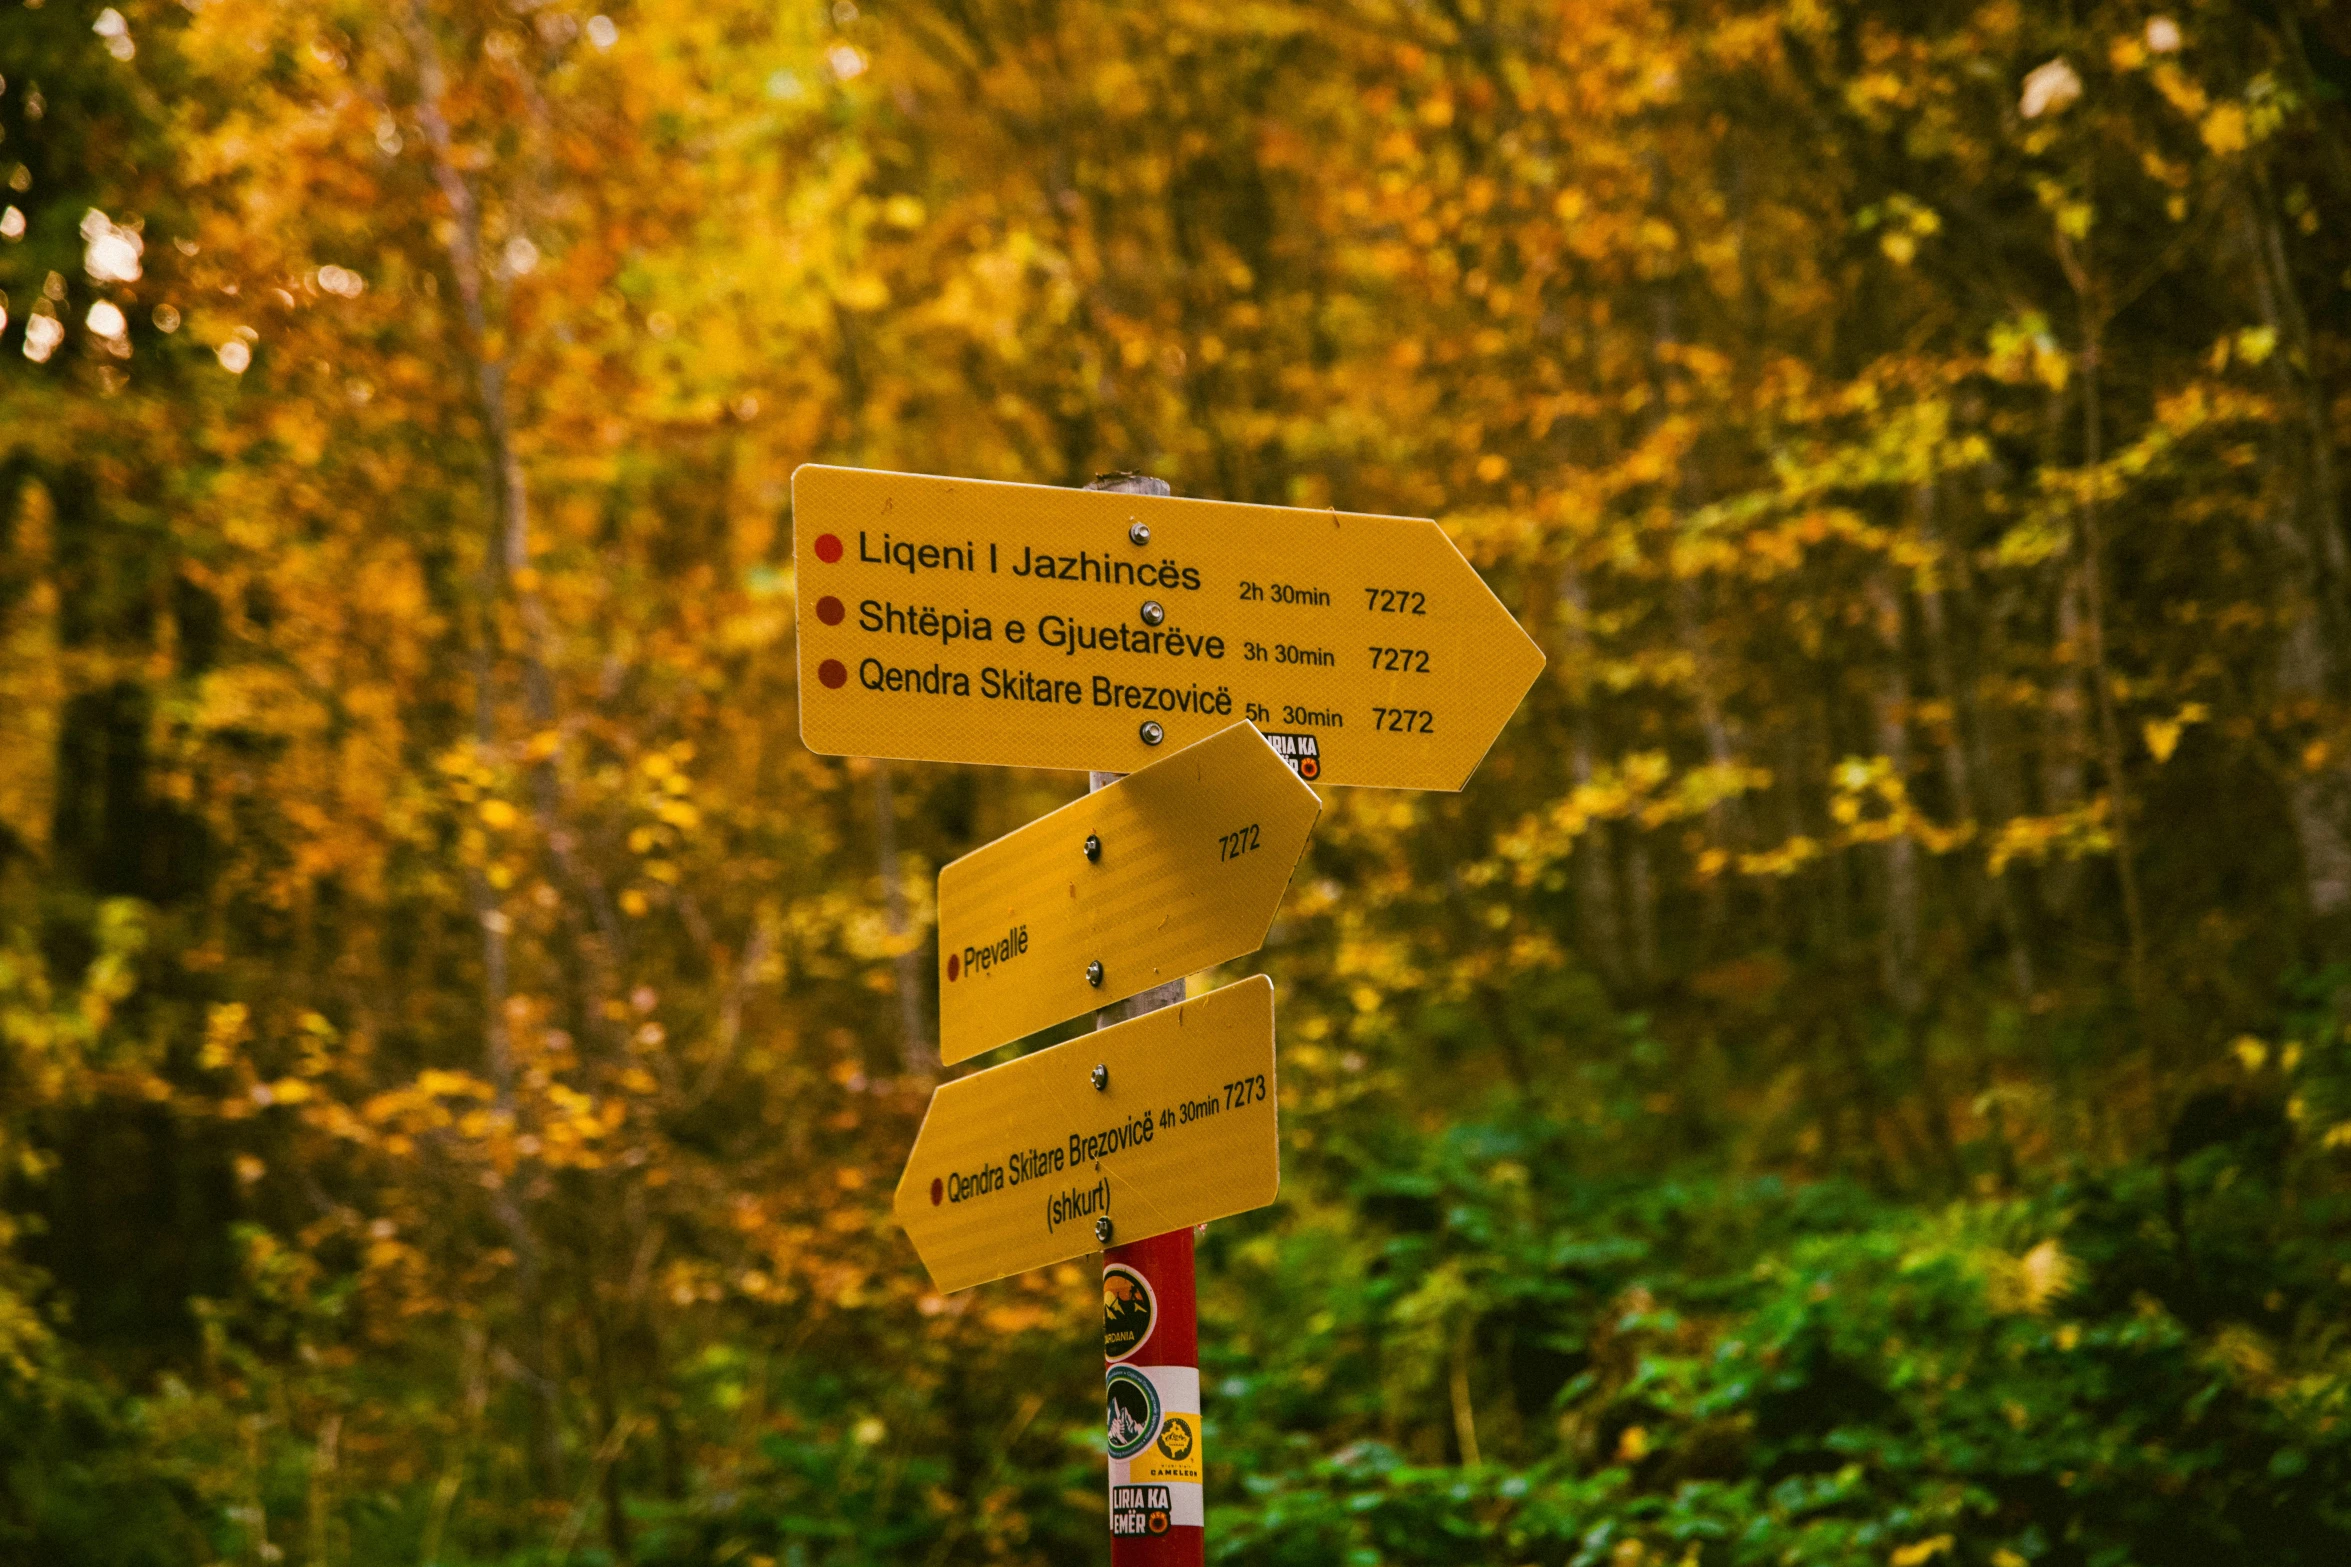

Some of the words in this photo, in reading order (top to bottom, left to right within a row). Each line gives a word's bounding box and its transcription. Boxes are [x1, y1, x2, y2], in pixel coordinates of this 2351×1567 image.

[859, 531, 975, 575] Liqeni
[1012, 547, 1201, 592] Jazhincës
[1239, 581, 1264, 602] 2h
[1270, 584, 1331, 606] 30min
[1365, 588, 1426, 616] 7272
[859, 599, 993, 646] Shtëpia
[1004, 620, 1026, 644] e
[1038, 615, 1225, 660] Gjuetarëve
[1243, 641, 1268, 662] 3h
[1274, 645, 1335, 667] 30min
[1368, 646, 1430, 673] 7272
[859, 657, 970, 698] Qendra
[980, 666, 1082, 705] Skitare
[1092, 675, 1232, 716] Brezovicë
[1245, 702, 1270, 723] 5h
[1282, 704, 1343, 728] 30min
[1372, 707, 1434, 734] 7272
[1297, 737, 1318, 756] KA
[1217, 822, 1261, 864] 7272
[963, 924, 1029, 978] Prevallë
[947, 1163, 1004, 1203] Qendra
[1008, 1147, 1065, 1186] Skitare
[1069, 1111, 1154, 1167] Brezovicë
[1158, 1108, 1176, 1130] 4h
[1179, 1095, 1220, 1125] 30min
[1223, 1073, 1267, 1111] 7273
[1047, 1176, 1111, 1234] (shkurt)
[1113, 1488, 1145, 1509] LIRIA
[1147, 1488, 1169, 1509] KA
[1150, 1469, 1198, 1477] CAMELEON
[1114, 1509, 1146, 1534] EMËR
